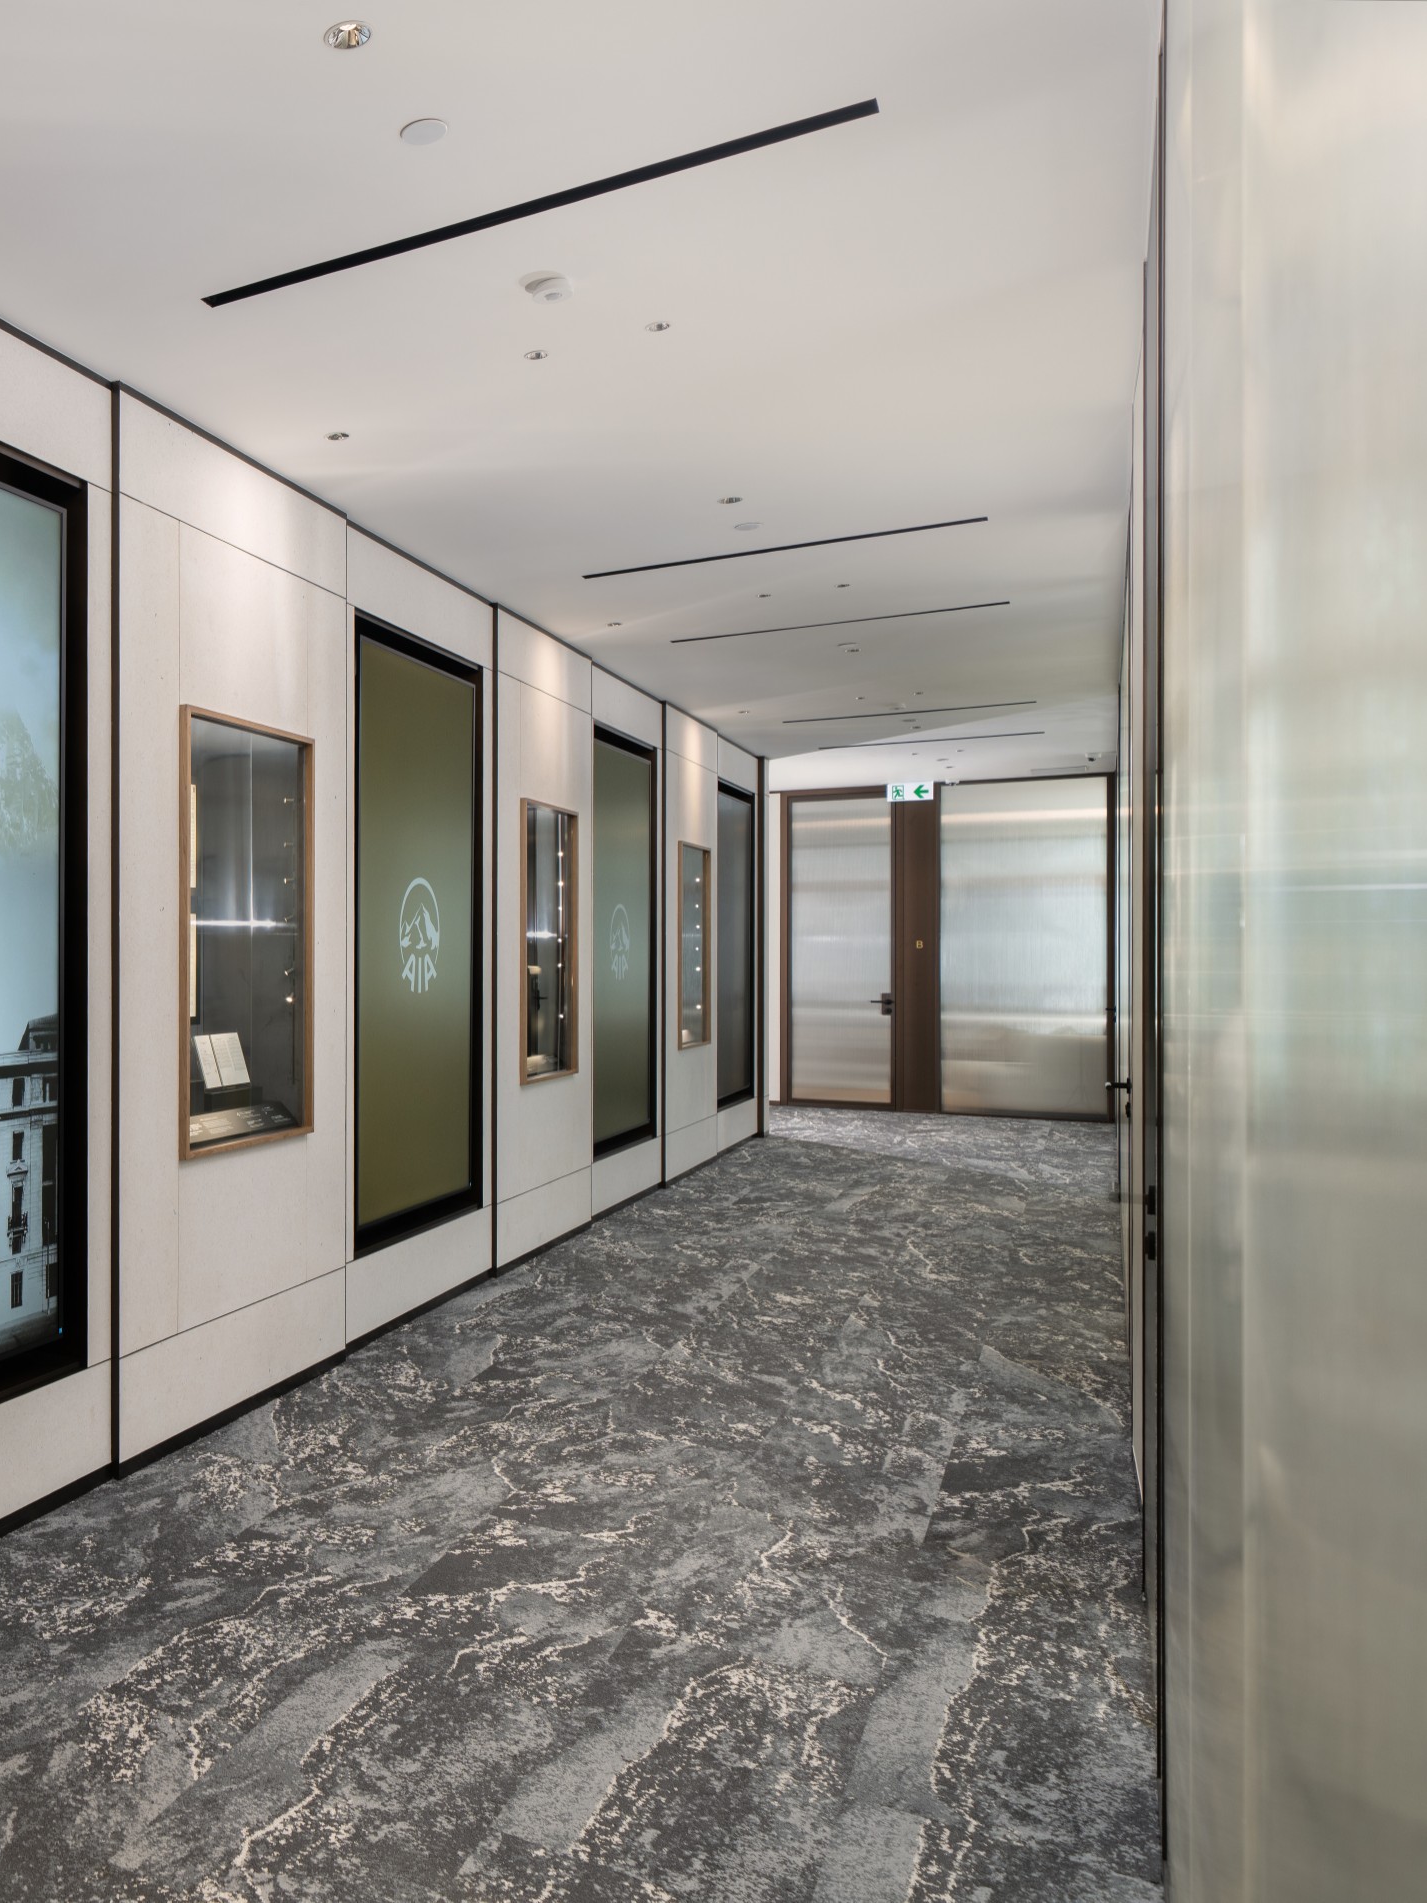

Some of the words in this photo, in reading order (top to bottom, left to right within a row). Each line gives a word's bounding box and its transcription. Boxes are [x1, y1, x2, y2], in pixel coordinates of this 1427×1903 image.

[916, 940, 923, 949] B
[401, 953, 437, 993] AIA
[610, 953, 629, 981] AIA
